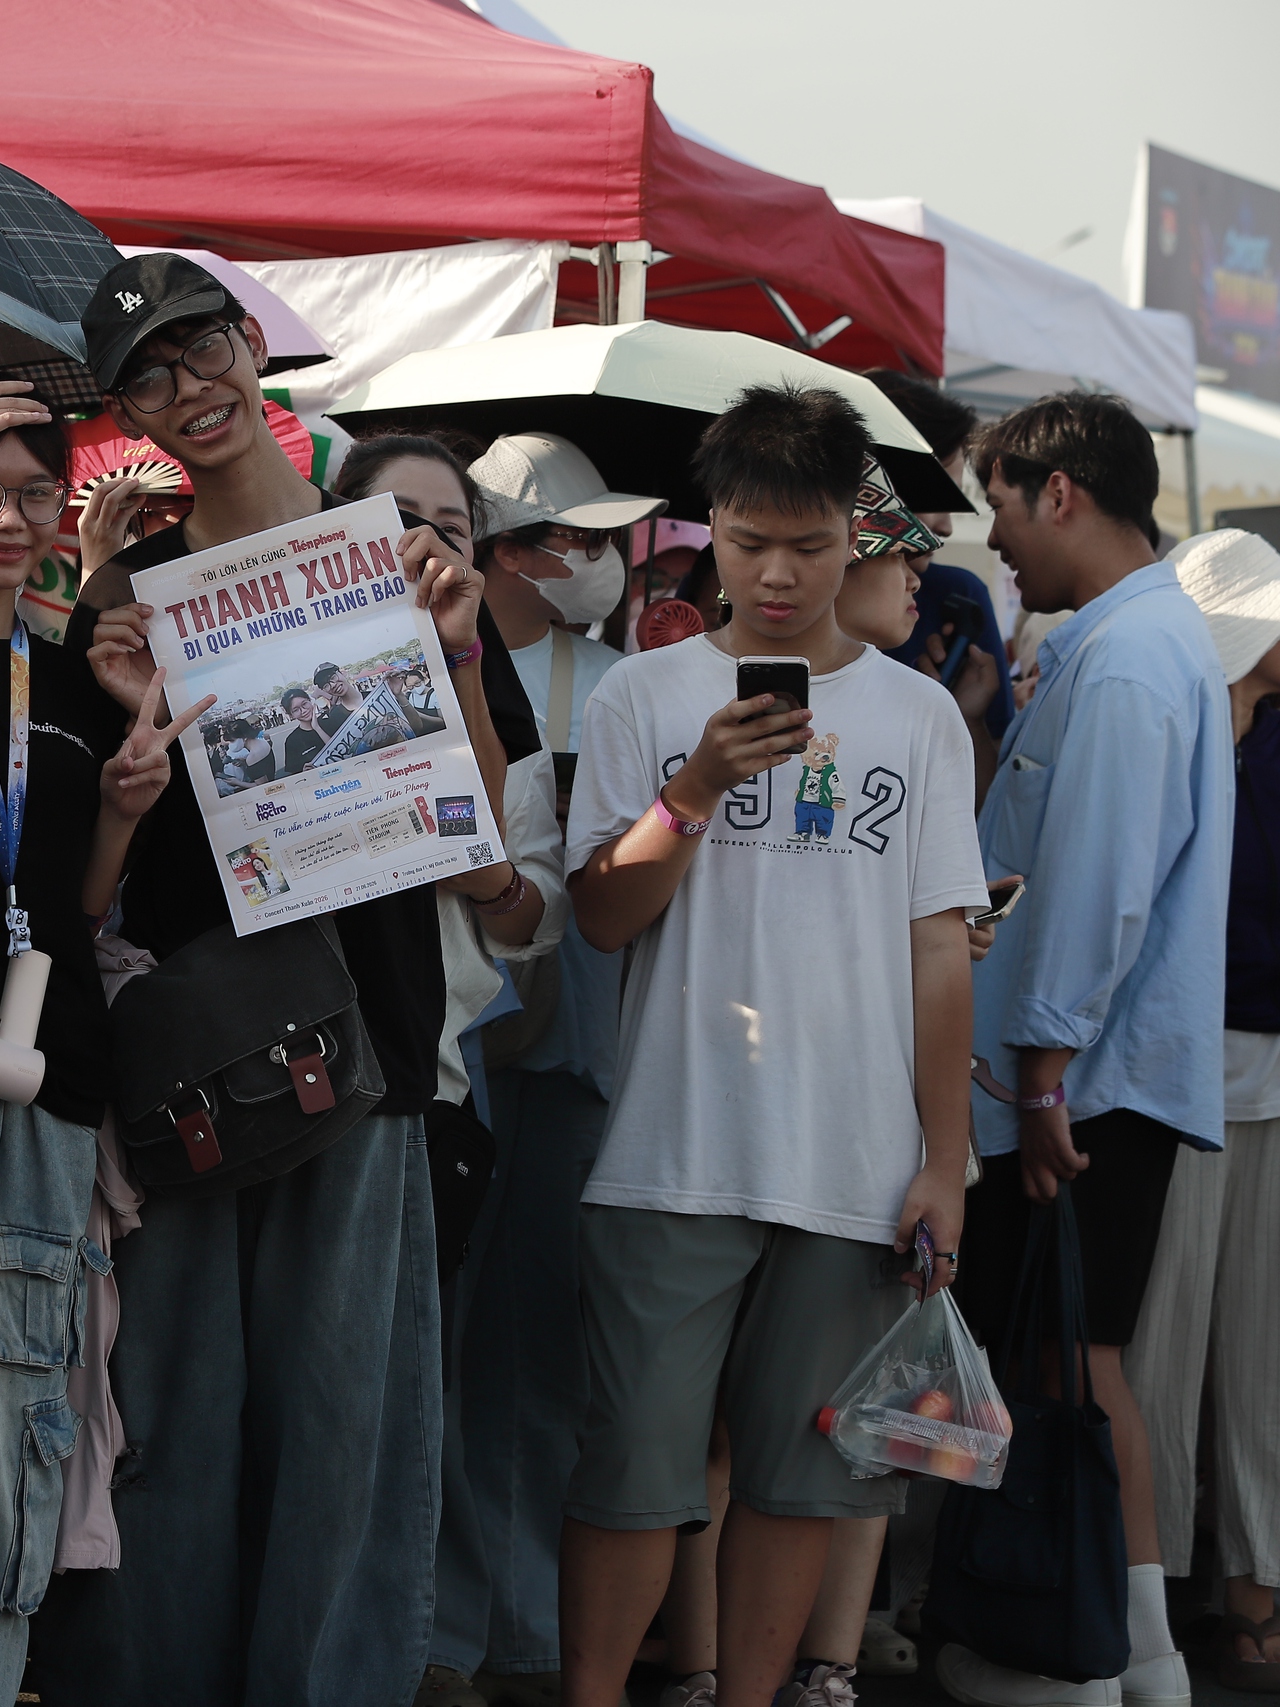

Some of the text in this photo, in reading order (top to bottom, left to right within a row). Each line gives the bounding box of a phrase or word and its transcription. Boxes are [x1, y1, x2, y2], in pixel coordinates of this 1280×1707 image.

[115, 291, 144, 313] LA
[200, 569, 216, 582] TÔI
[218, 563, 237, 577] LỚN
[239, 556, 258, 570] LÊN
[261, 548, 286, 563] CÙNG
[164, 536, 397, 639] THANH XUÂN
[182, 575, 405, 660] ĐI QUA NHỮNG TRANG BÁO
[380, 817, 399, 829] PHONG
[848, 765, 907, 856] 2
[368, 829, 390, 842] STADIUM
[710, 838, 853, 855] BEVERLY HILLS POLO CLUB
[264, 907, 284, 918] Concert
[284, 903, 300, 911] Thanh
[313, 894, 328, 903] 2026
[318, 898, 348, 911] Created
[365, 886, 392, 898] Memory
[396, 876, 425, 888] Station
